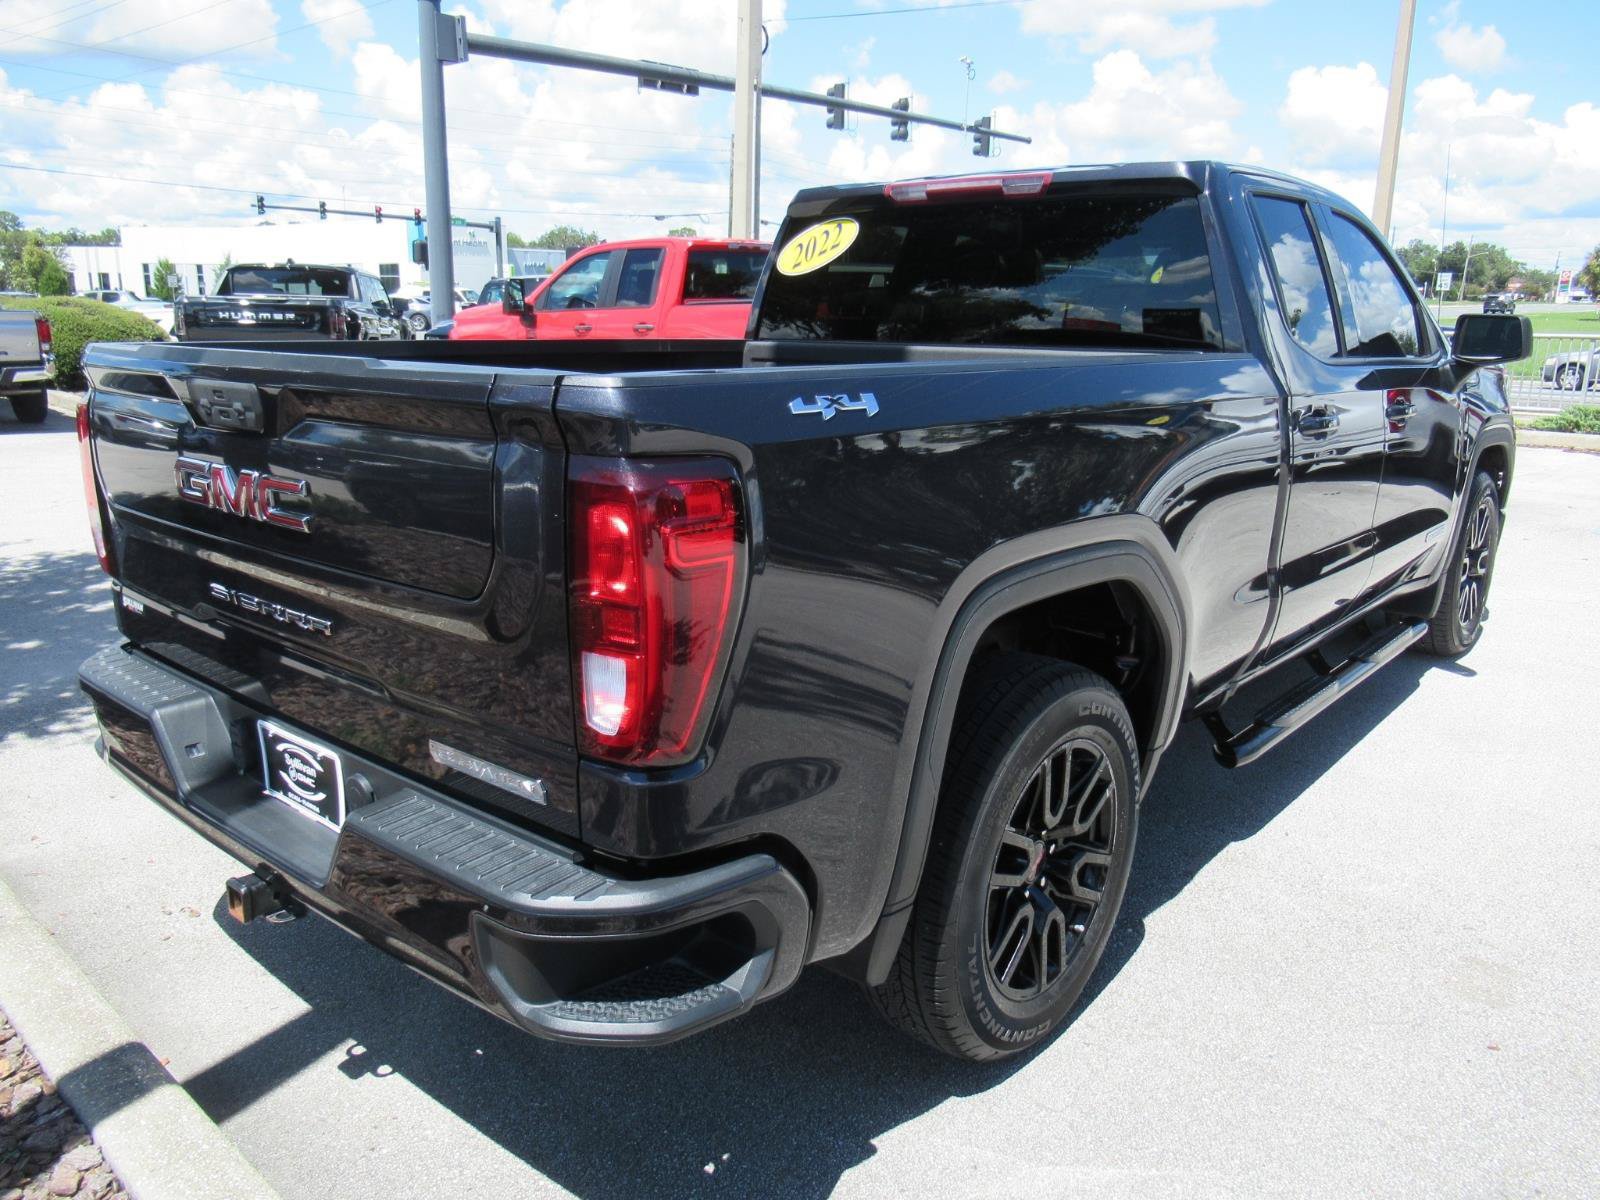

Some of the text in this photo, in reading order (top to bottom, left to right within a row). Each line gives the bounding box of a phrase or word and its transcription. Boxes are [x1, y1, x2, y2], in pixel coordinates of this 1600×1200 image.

[792, 223, 843, 270] 2022
[218, 311, 296, 320] HUMMER
[174, 456, 312, 534] GMC
[209, 582, 334, 636] SIERRA
